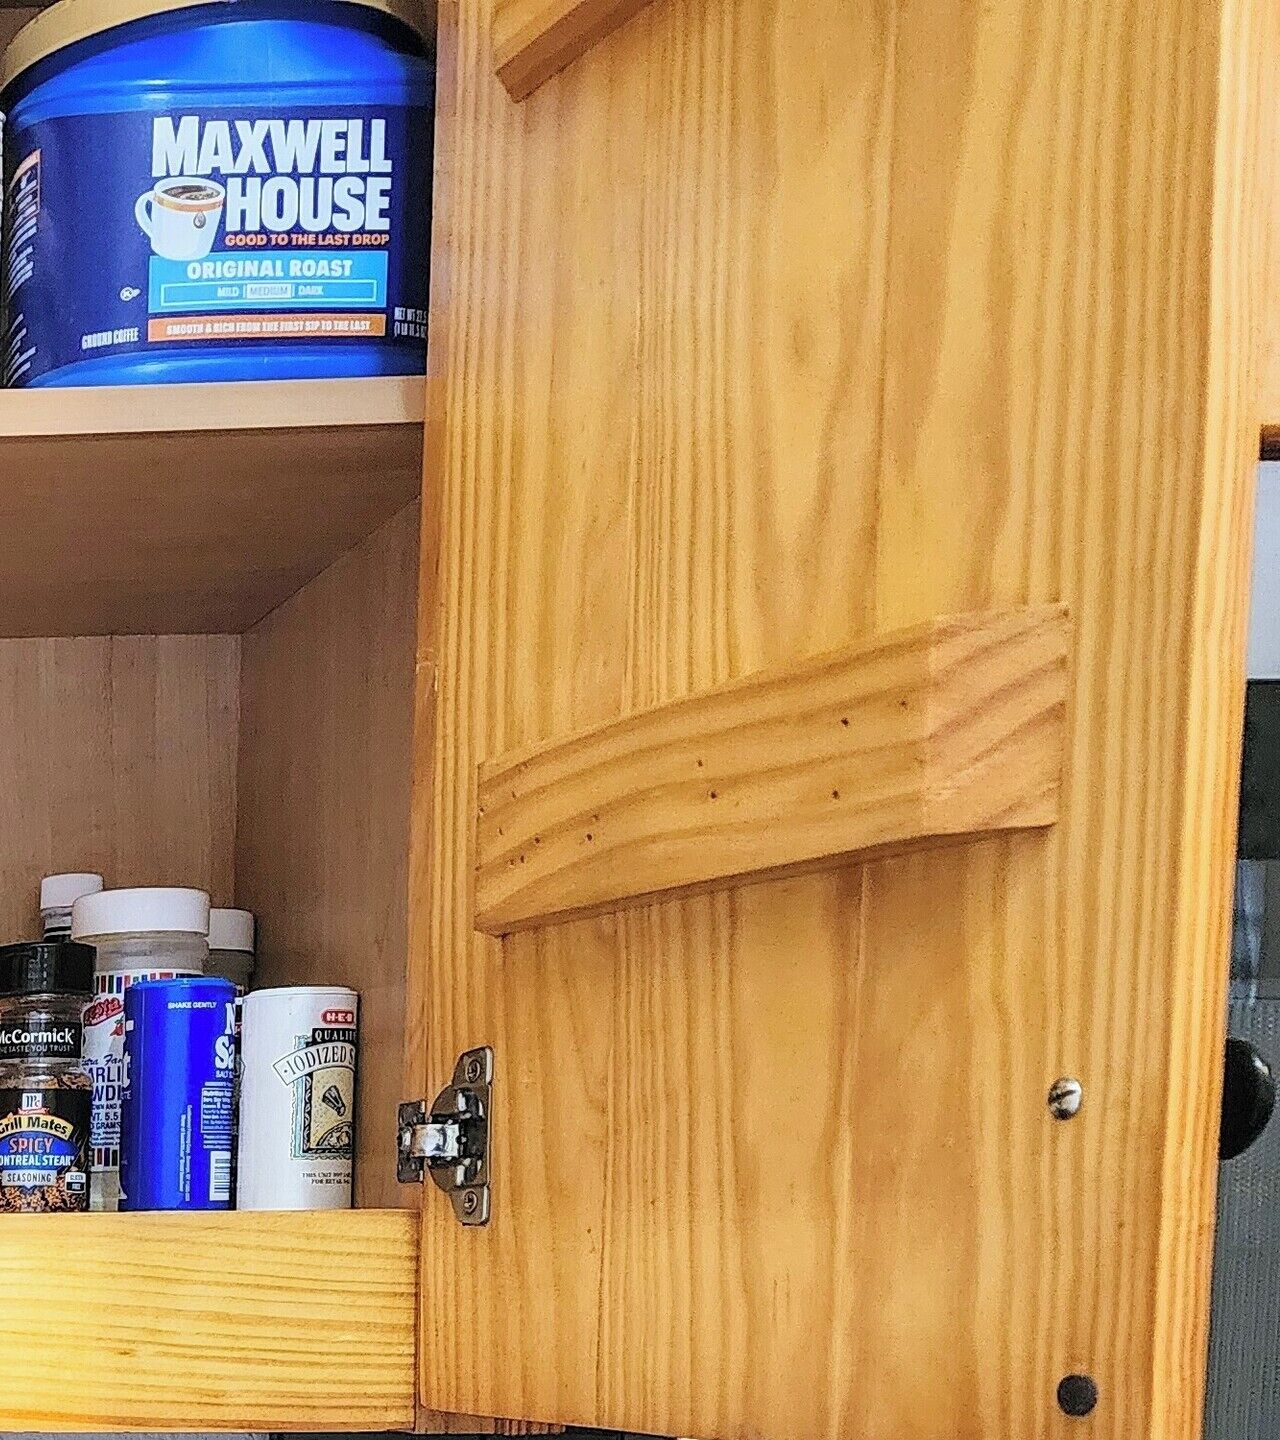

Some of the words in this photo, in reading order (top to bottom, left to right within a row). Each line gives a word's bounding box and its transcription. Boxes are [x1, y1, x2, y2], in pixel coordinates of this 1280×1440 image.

[151, 115, 393, 177] MAXWELL
[225, 176, 391, 232] HOUSE
[225, 234, 267, 247] GOOD
[269, 234, 288, 246] TO
[290, 234, 316, 246] THE
[318, 233, 350, 246] LAST
[352, 233, 389, 246] DROP
[187, 260, 285, 280] ORIGINAL
[289, 259, 353, 278] ROAST
[31, 1044, 48, 1052] YOU
[288, 1045, 347, 1076] IODIZED
[27, 1117, 67, 1135] Mates
[9, 1138, 53, 1153] SPICY
[7, 1172, 51, 1183] SEASONING
